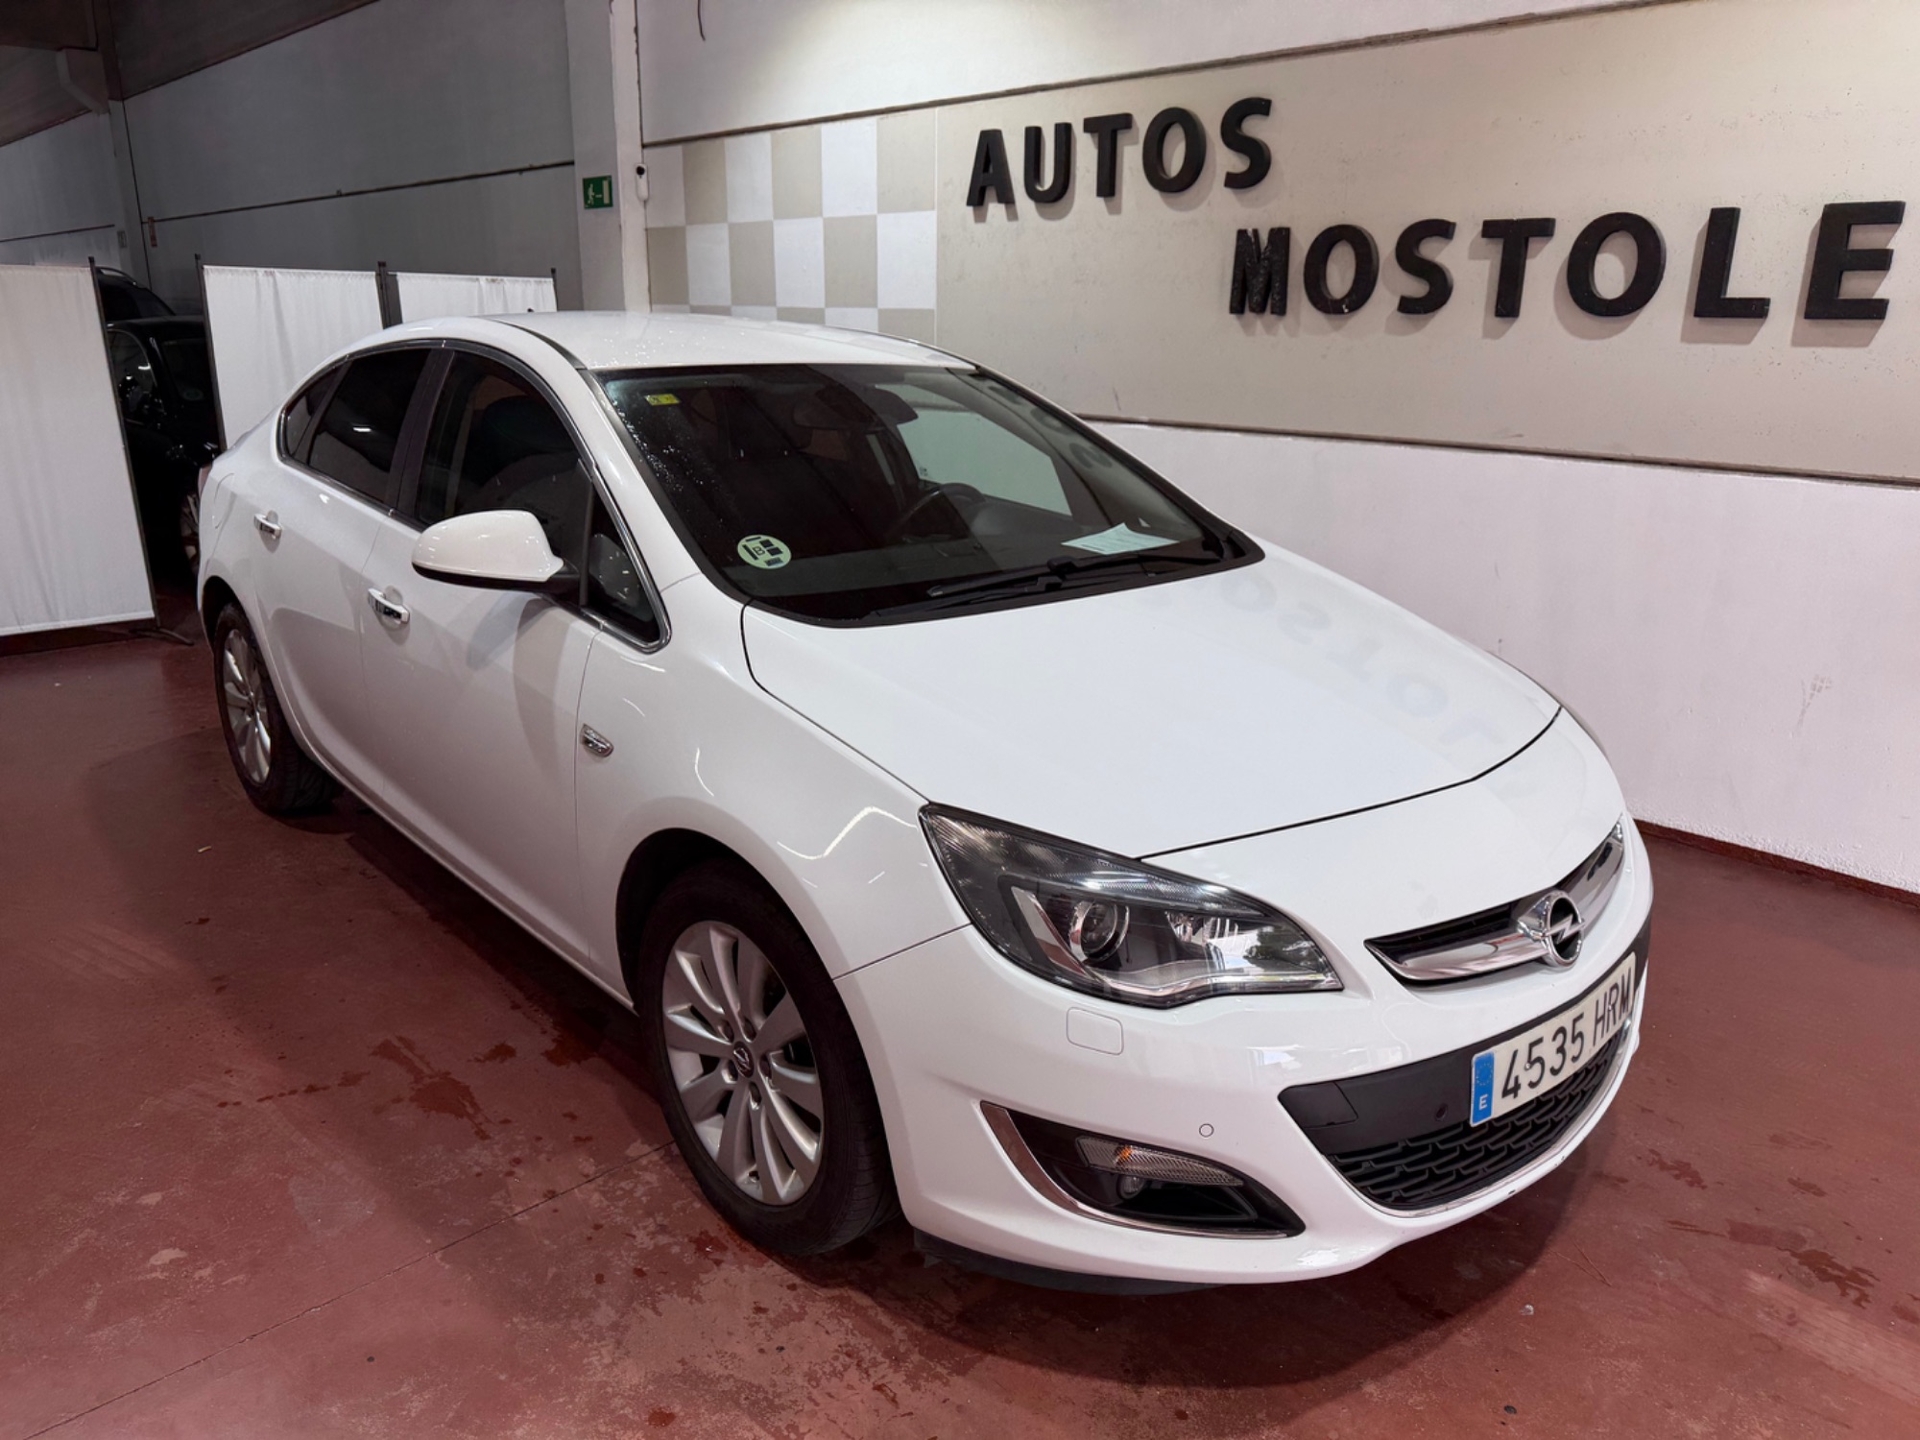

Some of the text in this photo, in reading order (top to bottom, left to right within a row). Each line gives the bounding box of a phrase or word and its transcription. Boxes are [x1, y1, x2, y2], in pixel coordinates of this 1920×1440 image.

[966, 97, 1272, 206] AUTOS
[1229, 201, 1906, 320] MOSTOLE
[1478, 967, 1632, 1110] E 4535 HRM
